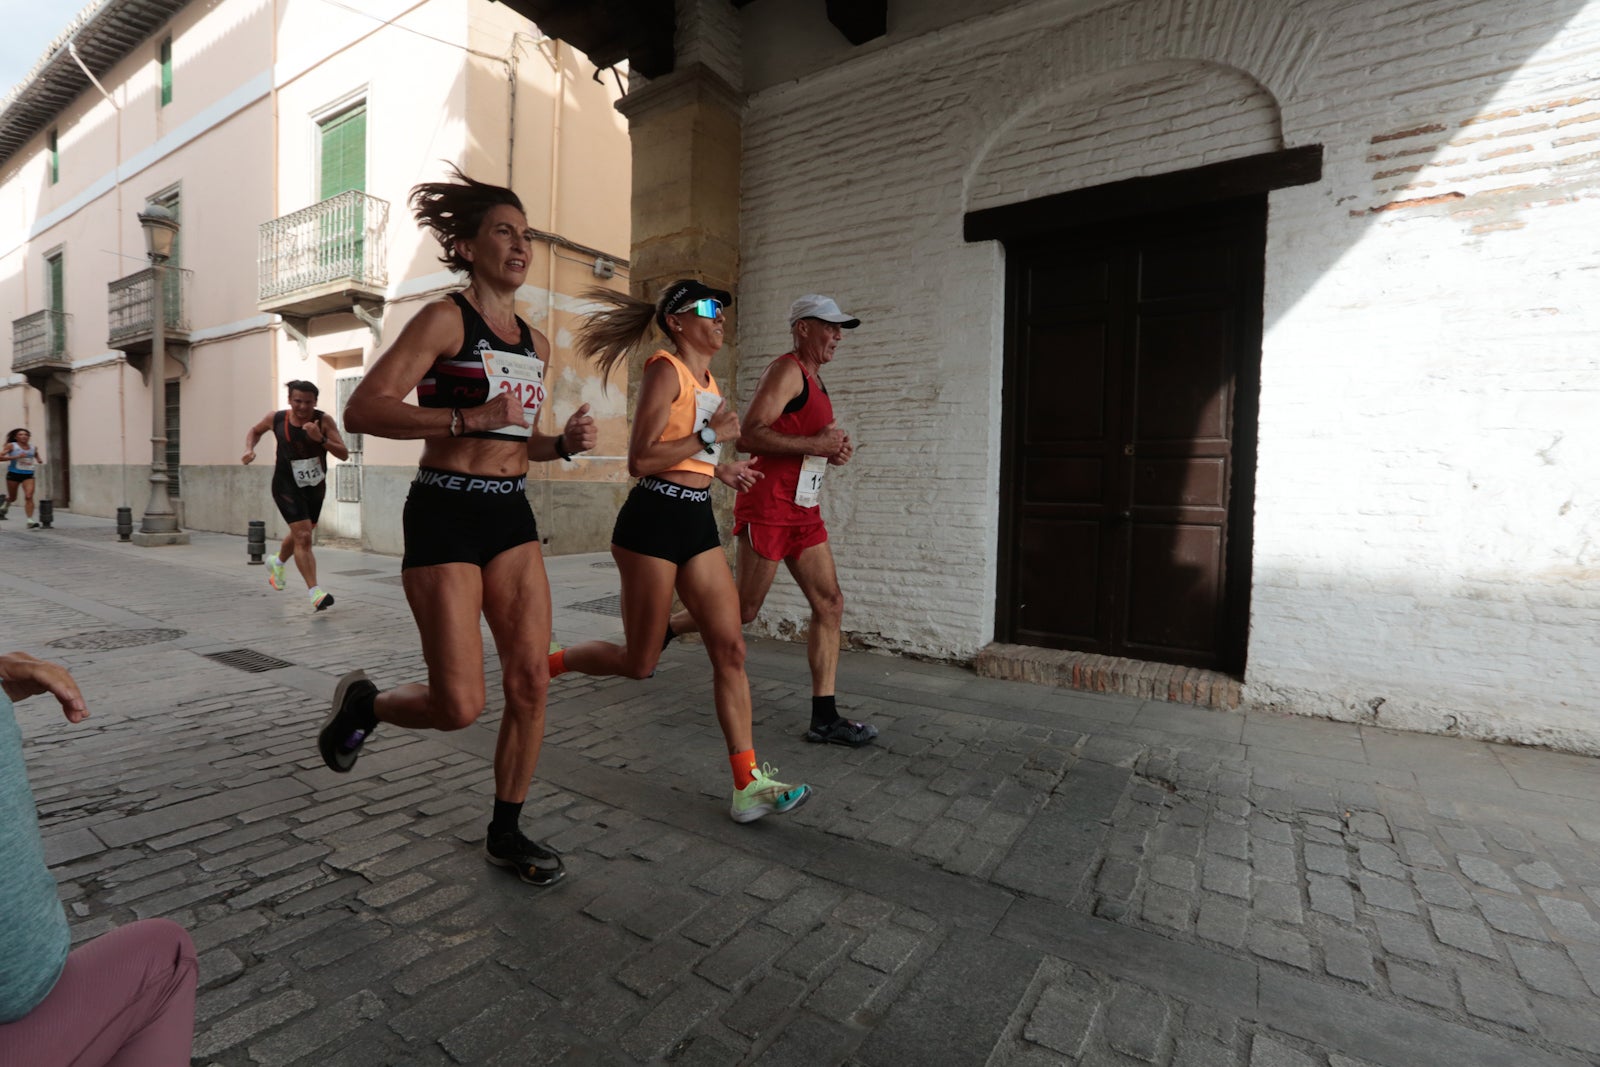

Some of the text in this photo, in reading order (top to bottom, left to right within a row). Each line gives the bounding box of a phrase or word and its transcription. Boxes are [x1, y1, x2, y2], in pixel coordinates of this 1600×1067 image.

[415, 469, 466, 491] NIKE
[466, 478, 514, 494] PRO
[640, 478, 681, 498] NIKE
[680, 488, 708, 503] PRO
